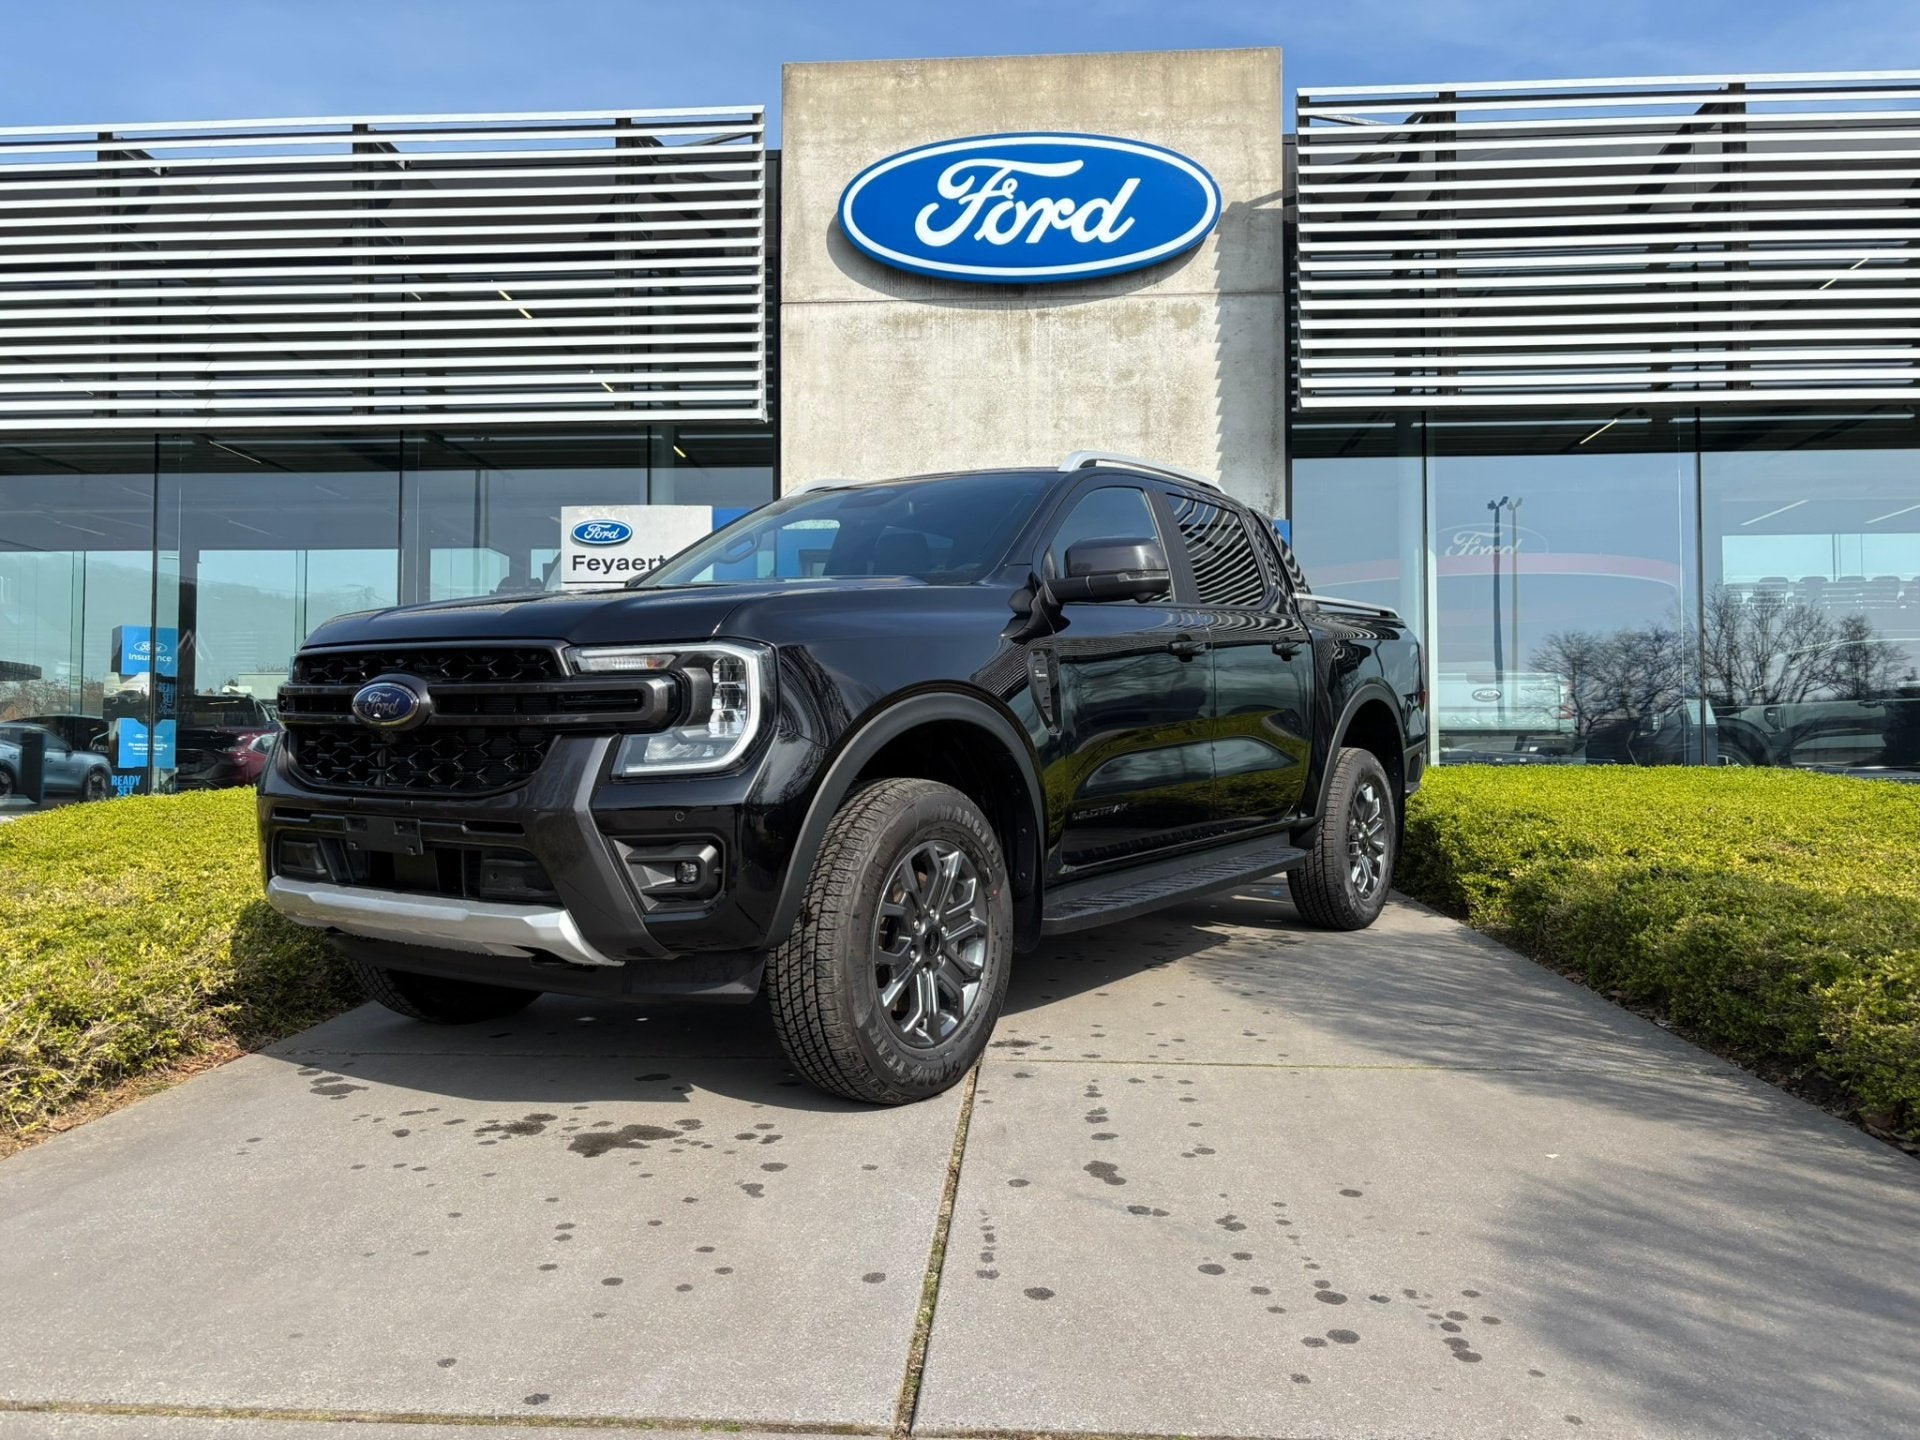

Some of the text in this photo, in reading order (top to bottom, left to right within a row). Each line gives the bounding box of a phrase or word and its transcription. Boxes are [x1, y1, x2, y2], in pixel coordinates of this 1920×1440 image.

[914, 158, 1141, 247] Ford
[584, 523, 619, 540] Ford
[572, 555, 666, 575] Feyaert
[128, 653, 172, 662] Insurnce
[364, 691, 400, 715] Ford
[111, 774, 141, 786] READY
[117, 785, 134, 796] SET
